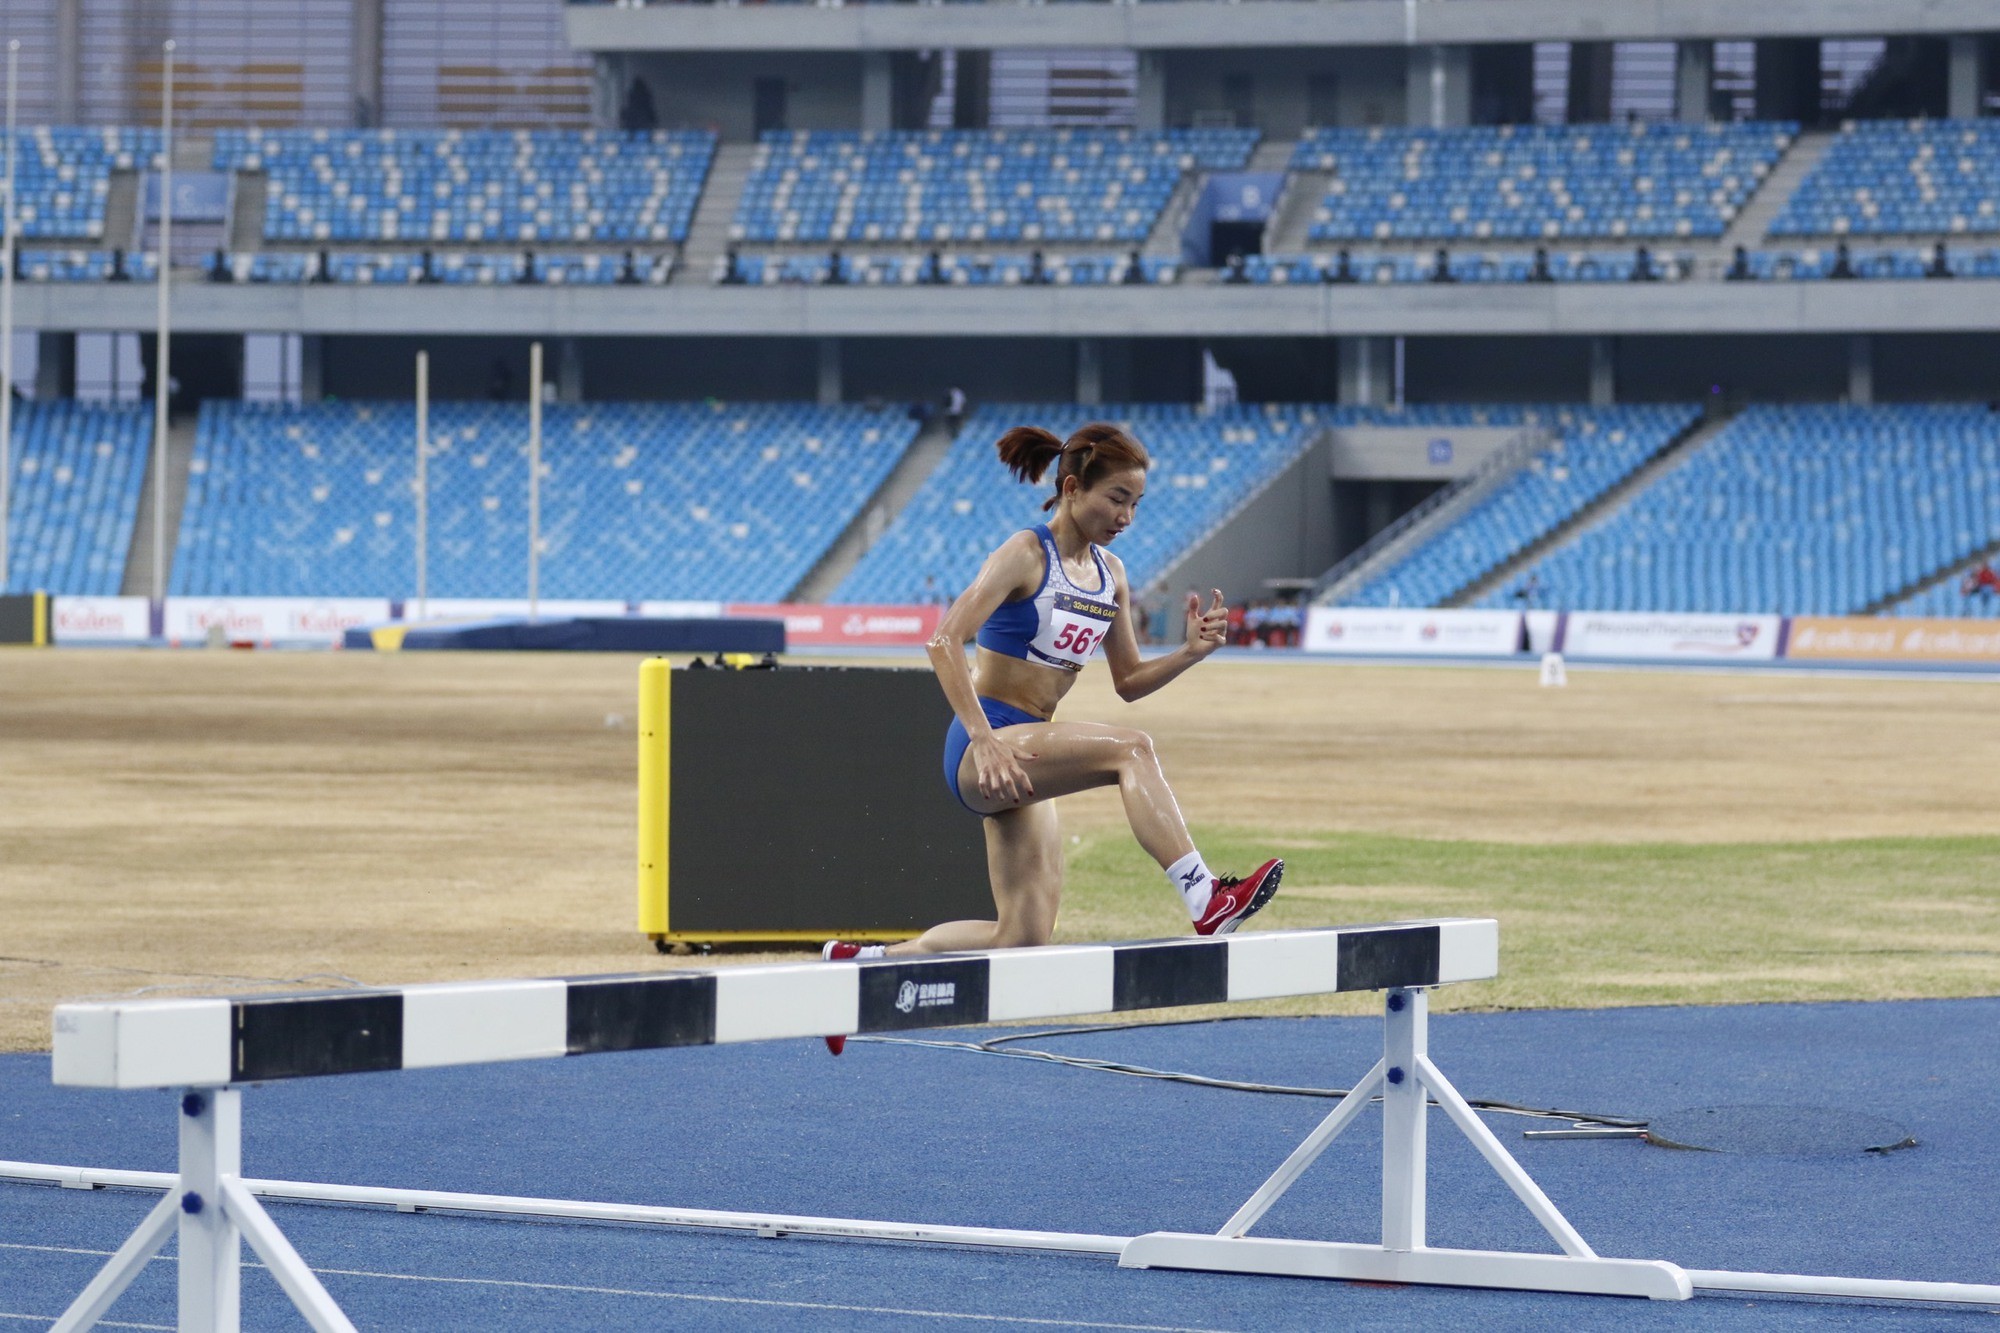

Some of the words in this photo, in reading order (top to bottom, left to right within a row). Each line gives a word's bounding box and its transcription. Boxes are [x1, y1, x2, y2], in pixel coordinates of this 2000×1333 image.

[1073, 600, 1089, 611] 32nd
[1089, 605, 1102, 615] SEA
[1053, 622, 1105, 656] 561
